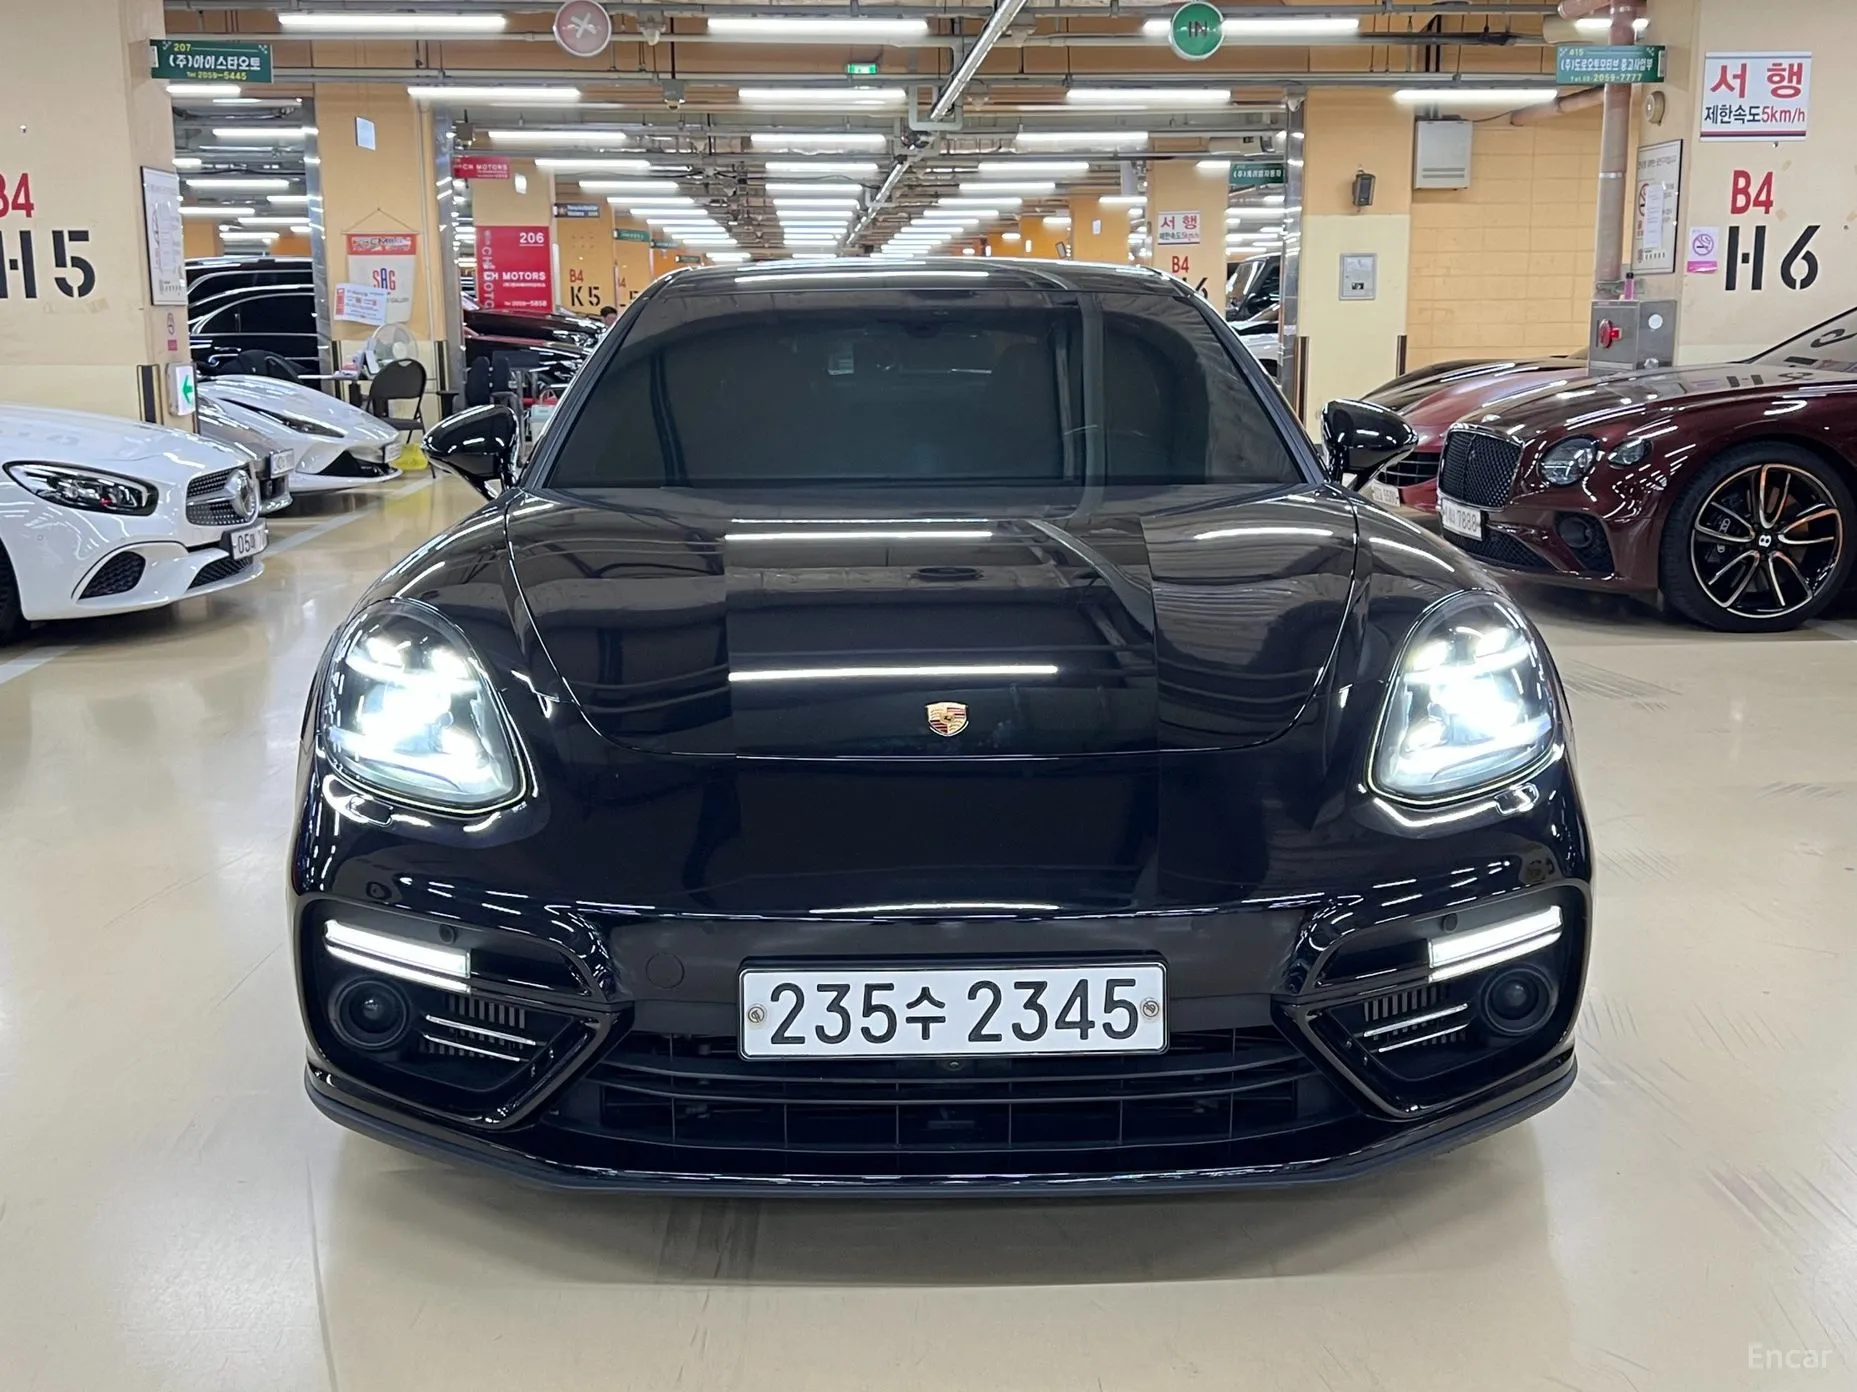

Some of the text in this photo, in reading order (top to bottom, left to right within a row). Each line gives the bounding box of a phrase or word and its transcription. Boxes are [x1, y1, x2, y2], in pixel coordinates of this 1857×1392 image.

[1188, 20, 1208, 37] IN
[173, 43, 191, 52] 207
[169, 54, 261, 70] (주)아이스타오토
[1730, 169, 1774, 215] B4
[519, 232, 545, 244] 206
[1171, 255, 1190, 274] B4
[502, 271, 547, 281] MOTORS
[569, 268, 584, 283] B4
[769, 978, 1139, 1045] 235수 2345
